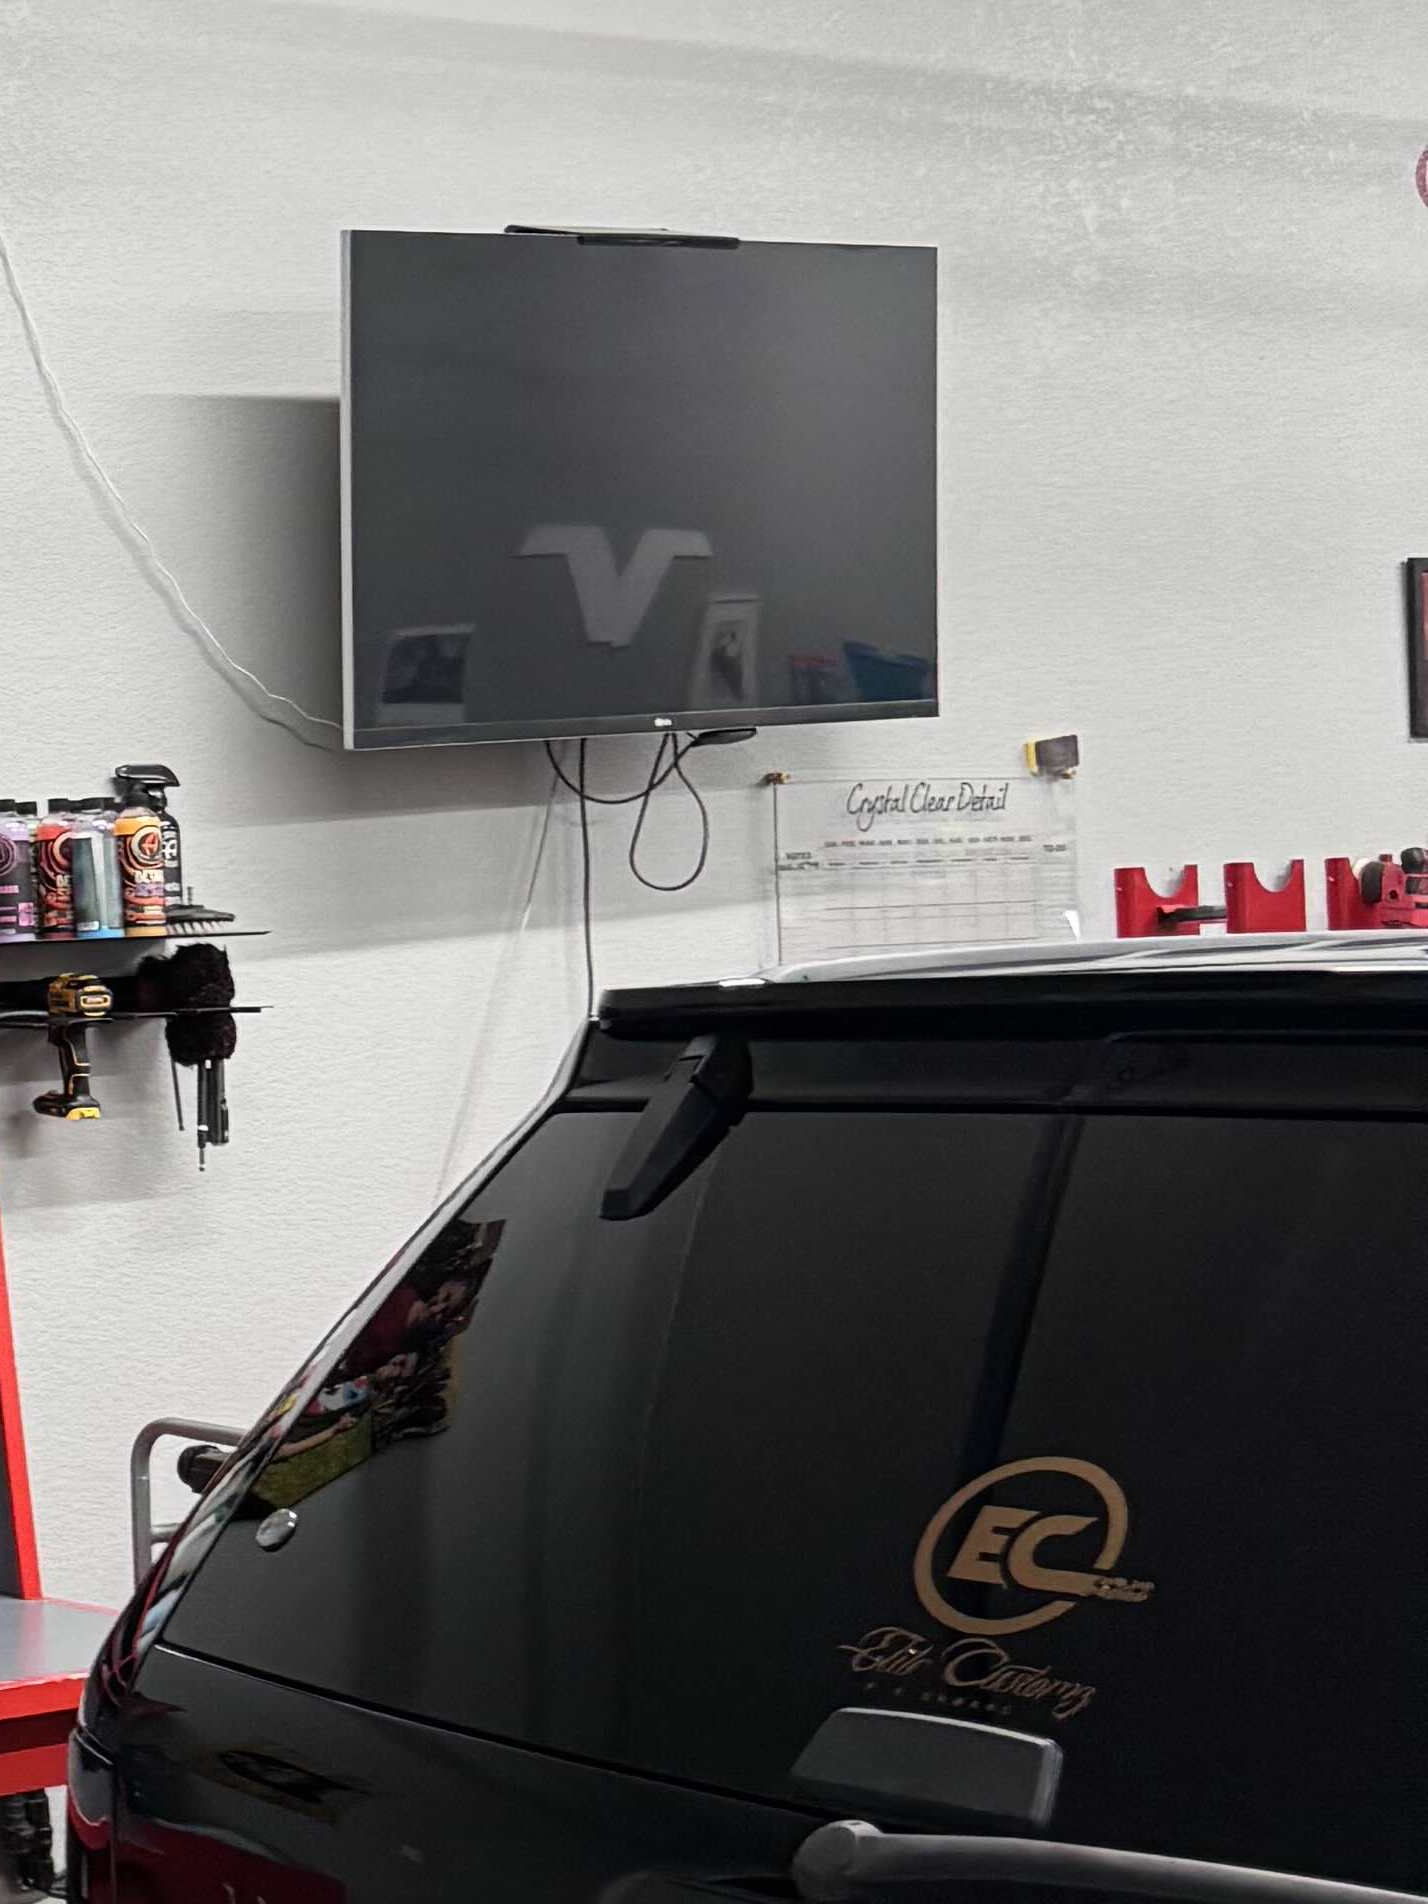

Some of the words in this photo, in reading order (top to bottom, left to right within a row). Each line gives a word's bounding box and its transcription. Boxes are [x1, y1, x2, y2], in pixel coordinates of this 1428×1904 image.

[846, 783, 907, 833] Crystal
[909, 782, 954, 814] Clear
[956, 782, 1010, 812] Detail
[948, 1504, 1102, 1596] EC
